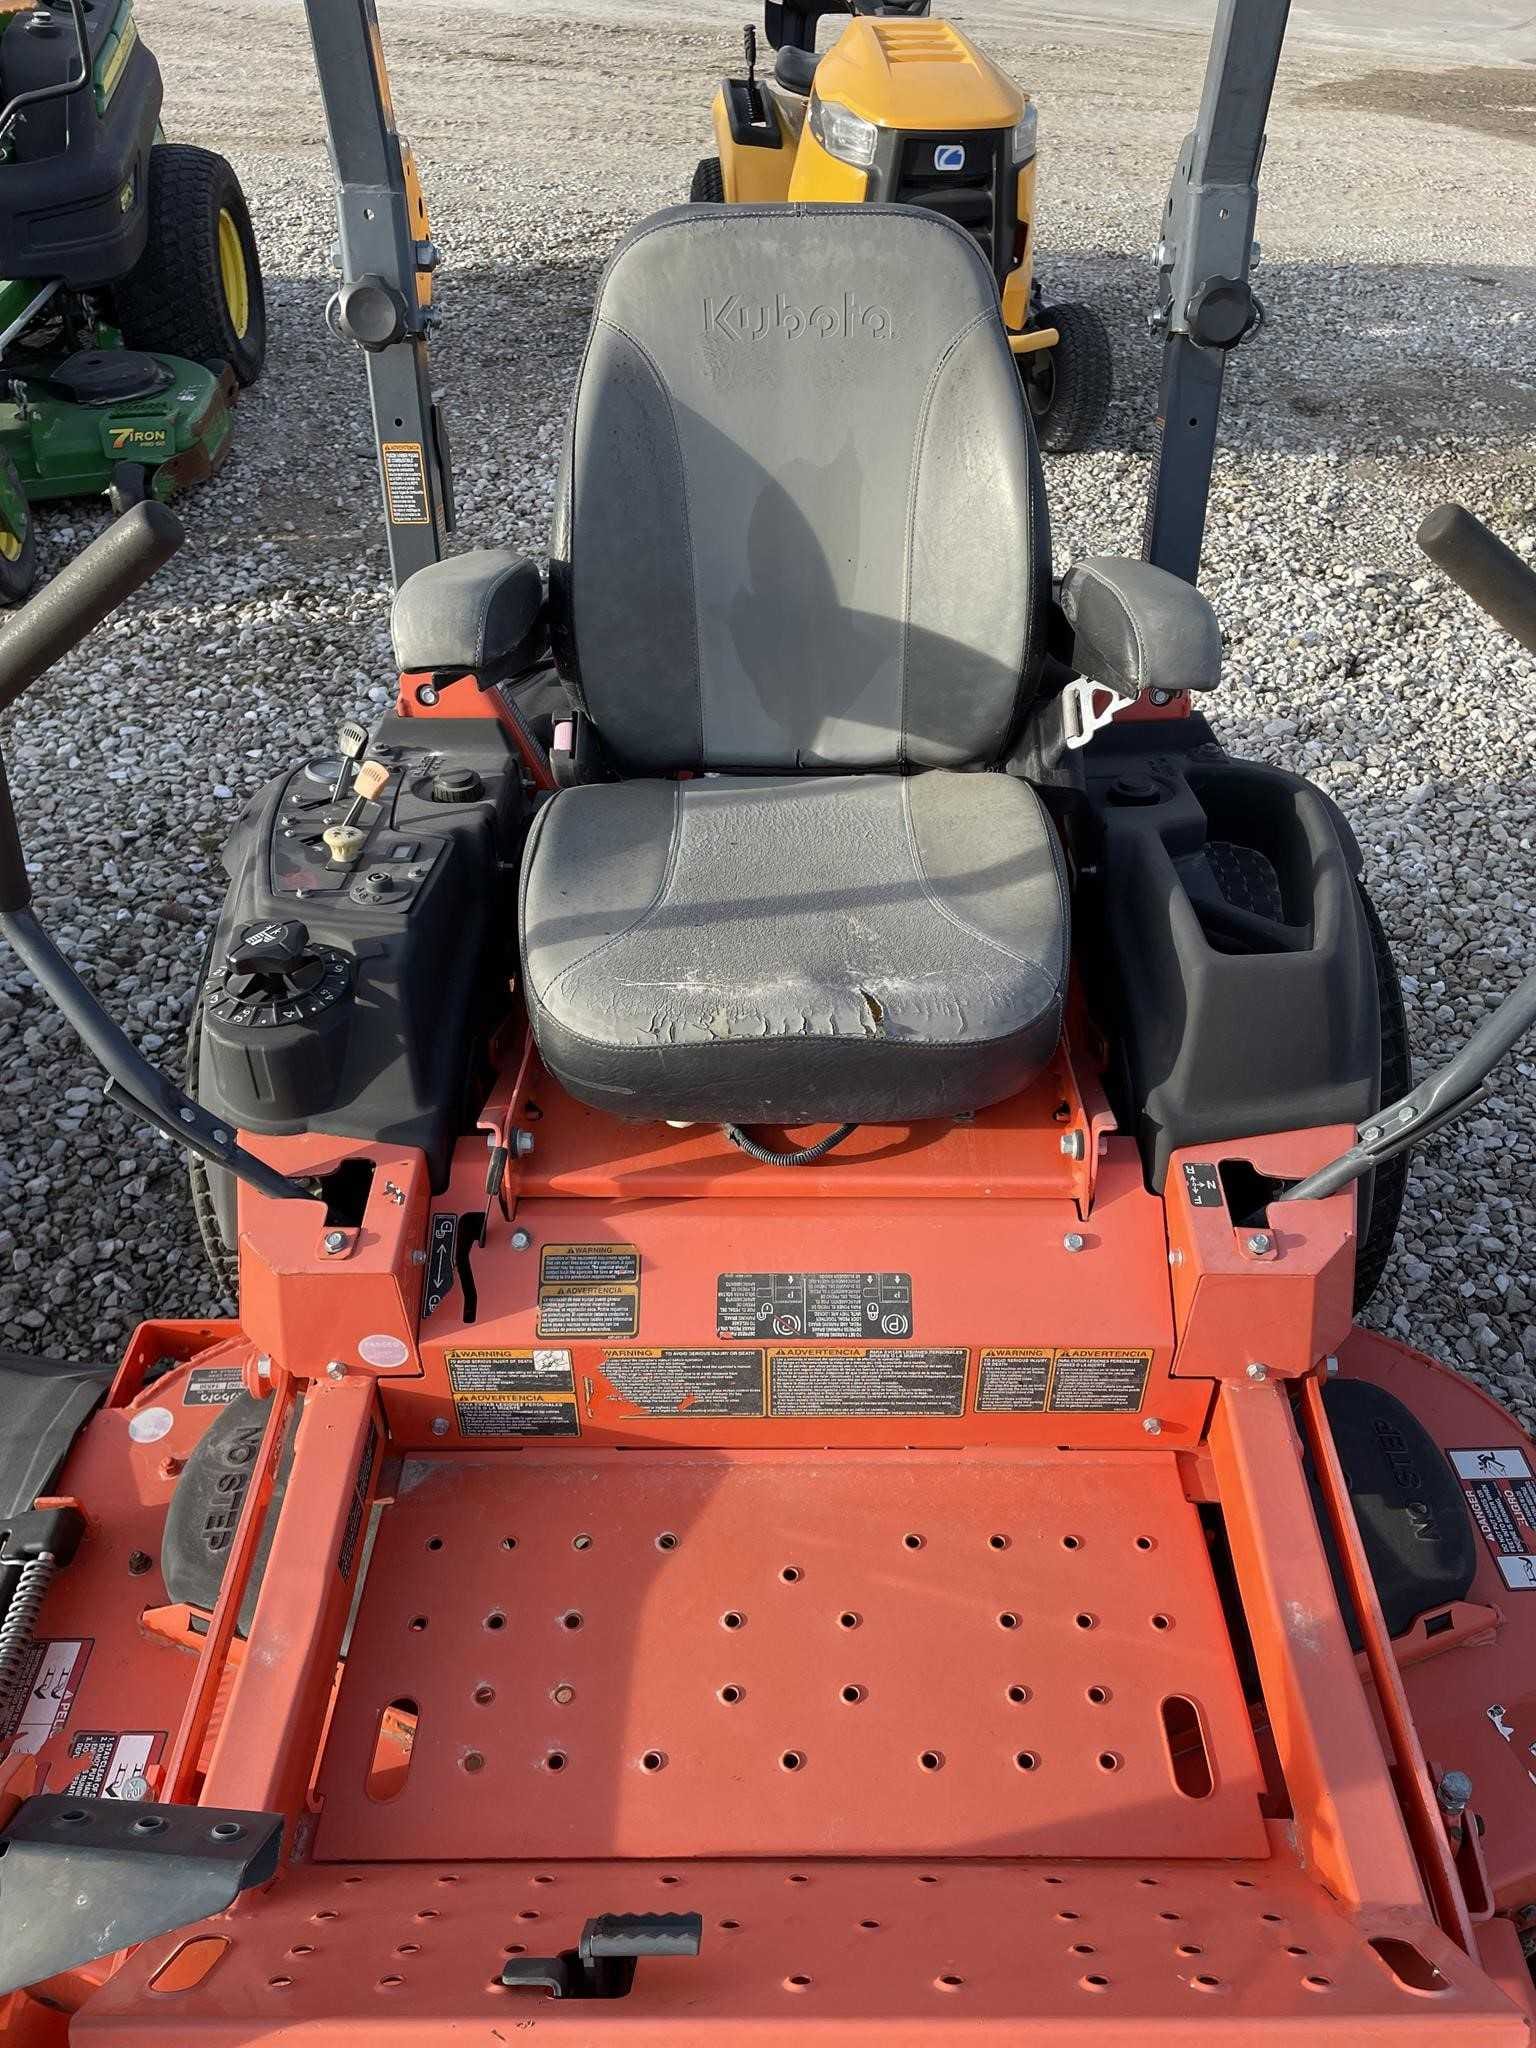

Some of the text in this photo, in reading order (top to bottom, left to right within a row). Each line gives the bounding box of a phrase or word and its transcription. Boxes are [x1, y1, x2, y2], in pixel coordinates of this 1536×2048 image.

[703, 291, 894, 342] Kubota
[282, 1009, 295, 1018] 4
[1185, 1165, 1196, 1175] R
[1206, 1180, 1217, 1190] N
[1193, 1195, 1203, 1205] F
[224, 1426, 265, 1465] NO
[1372, 1418, 1443, 1541] NO STEP
[203, 1472, 249, 1552] STEP
[1465, 1490, 1491, 1533] DANGER
[98, 1743, 106, 1752] DO
[103, 1743, 113, 1760] STAY
[96, 1761, 108, 1782] CLEAR
[92, 1783, 100, 1792] OF
